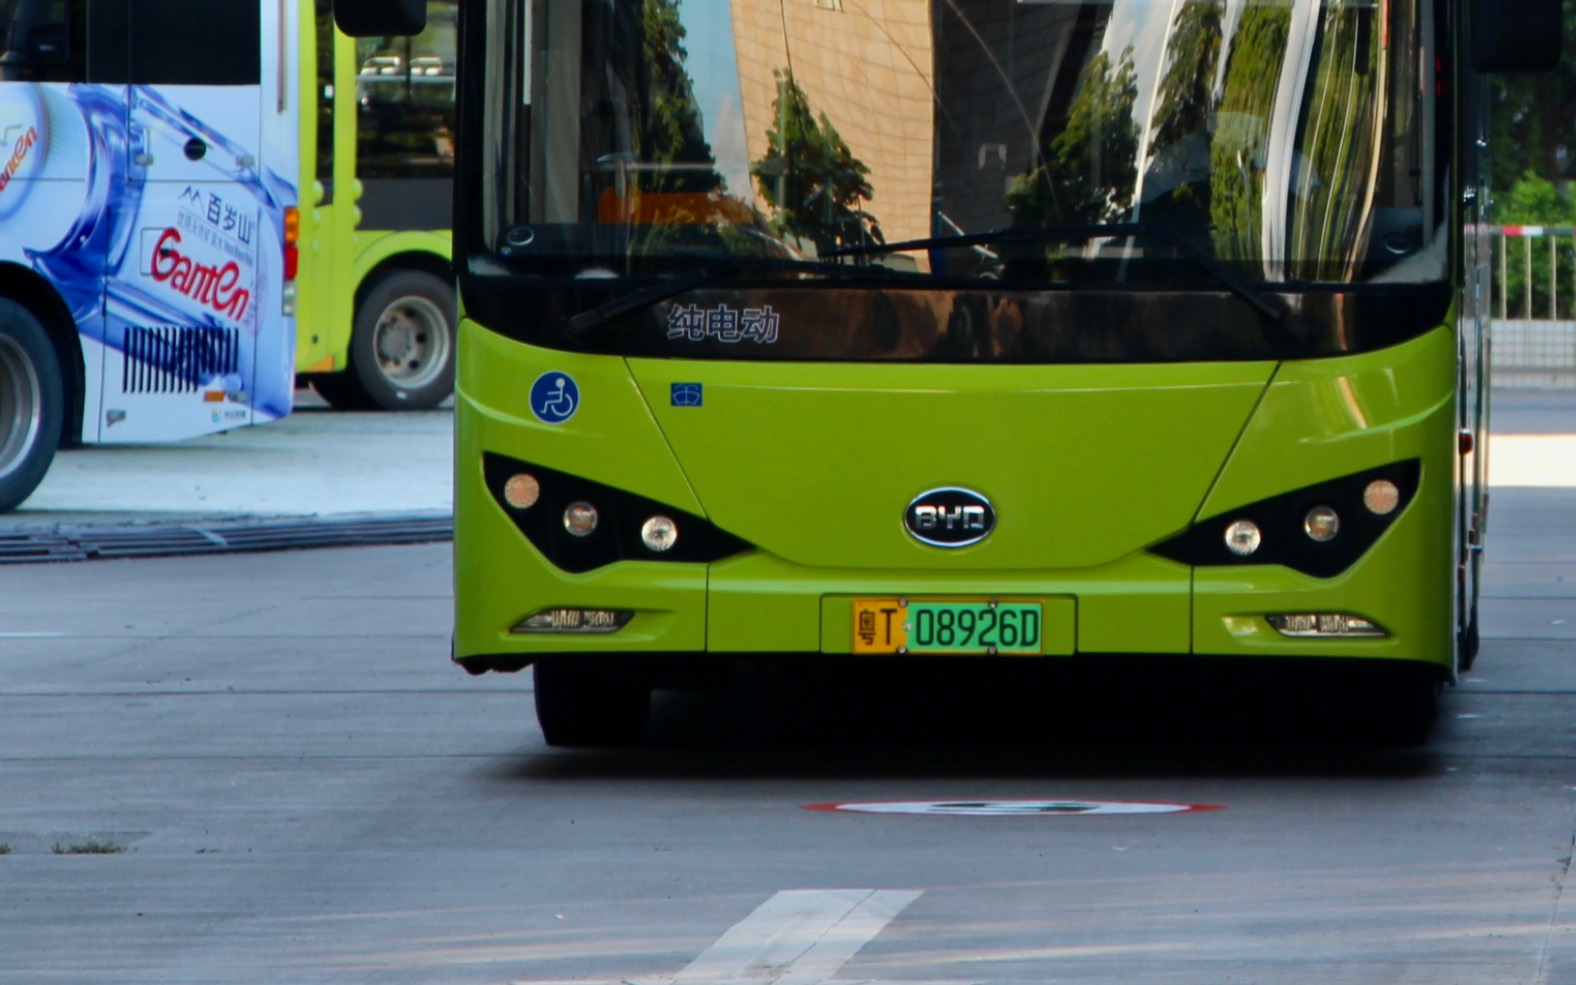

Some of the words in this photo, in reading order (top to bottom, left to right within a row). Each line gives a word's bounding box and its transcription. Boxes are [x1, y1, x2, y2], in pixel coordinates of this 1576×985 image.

[207, 191, 252, 245] 百岁山
[151, 227, 250, 322] Ganten
[666, 303, 780, 344] 纯电动
[914, 504, 985, 530] BYD
[915, 608, 1039, 647] 08926D
